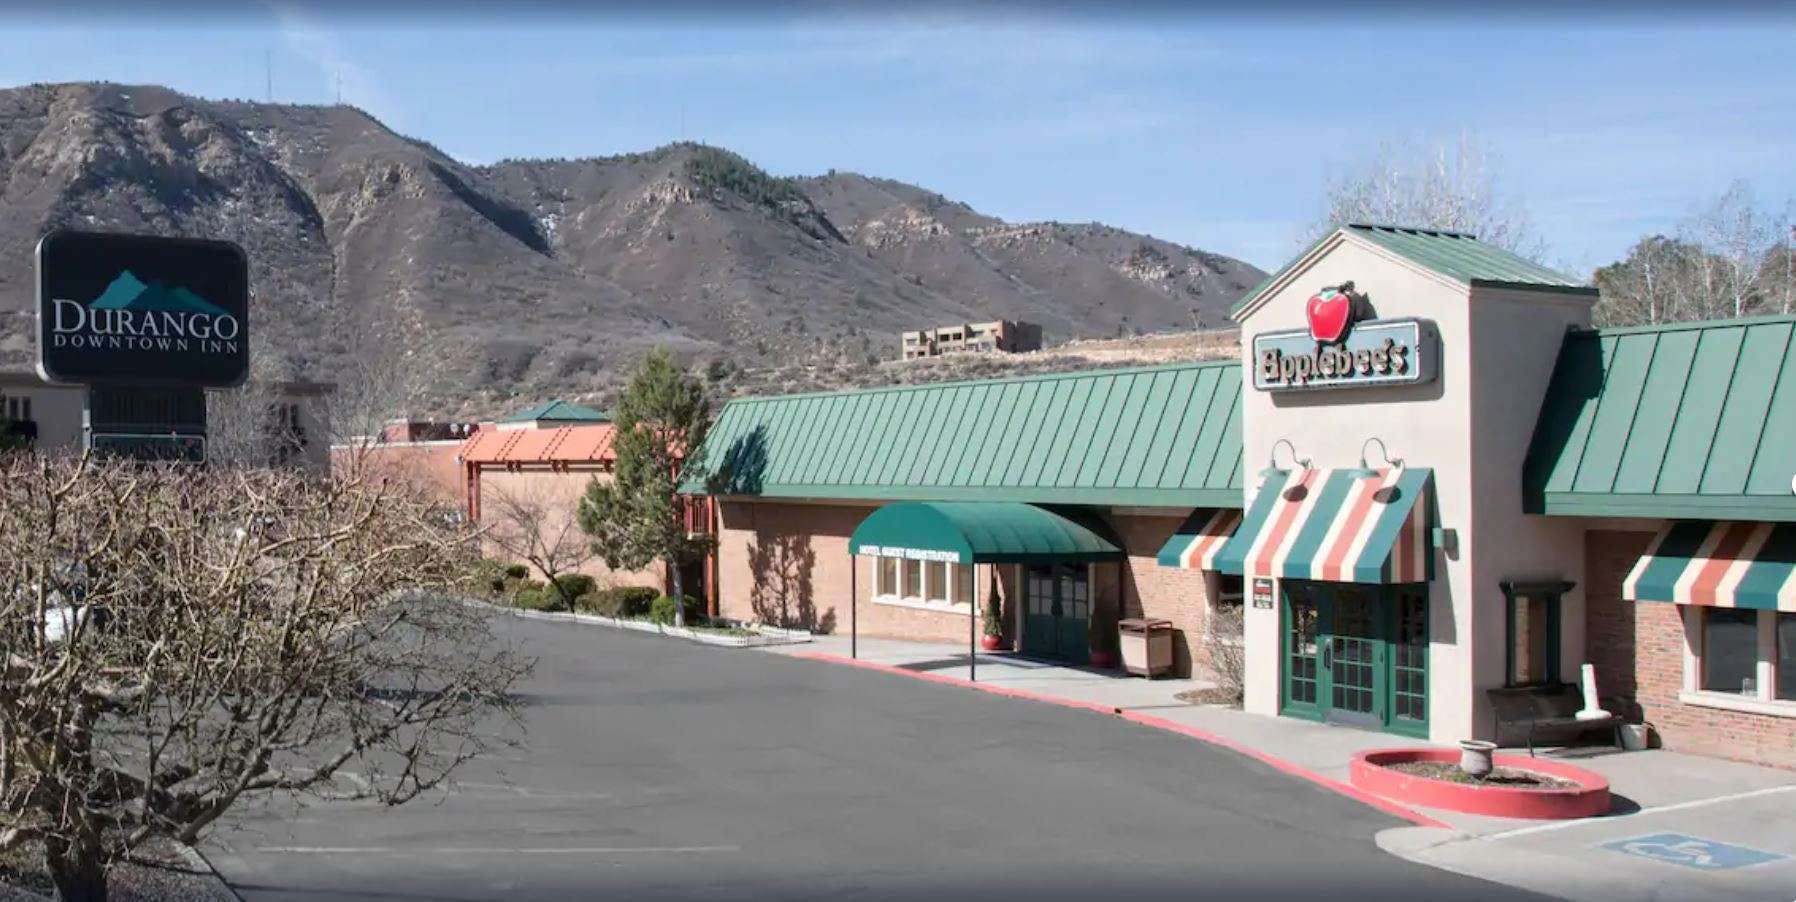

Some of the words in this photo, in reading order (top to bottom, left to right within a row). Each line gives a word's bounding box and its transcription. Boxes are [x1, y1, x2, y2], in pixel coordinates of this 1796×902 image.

[52, 299, 239, 340] DURANGO
[54, 334, 188, 351] DOWNTOWN
[201, 340, 238, 353] INN
[1261, 338, 1408, 384] Applebee's
[859, 545, 881, 556] HOTEL
[882, 546, 905, 558] GUEST
[905, 548, 960, 562] REGISTRATION
